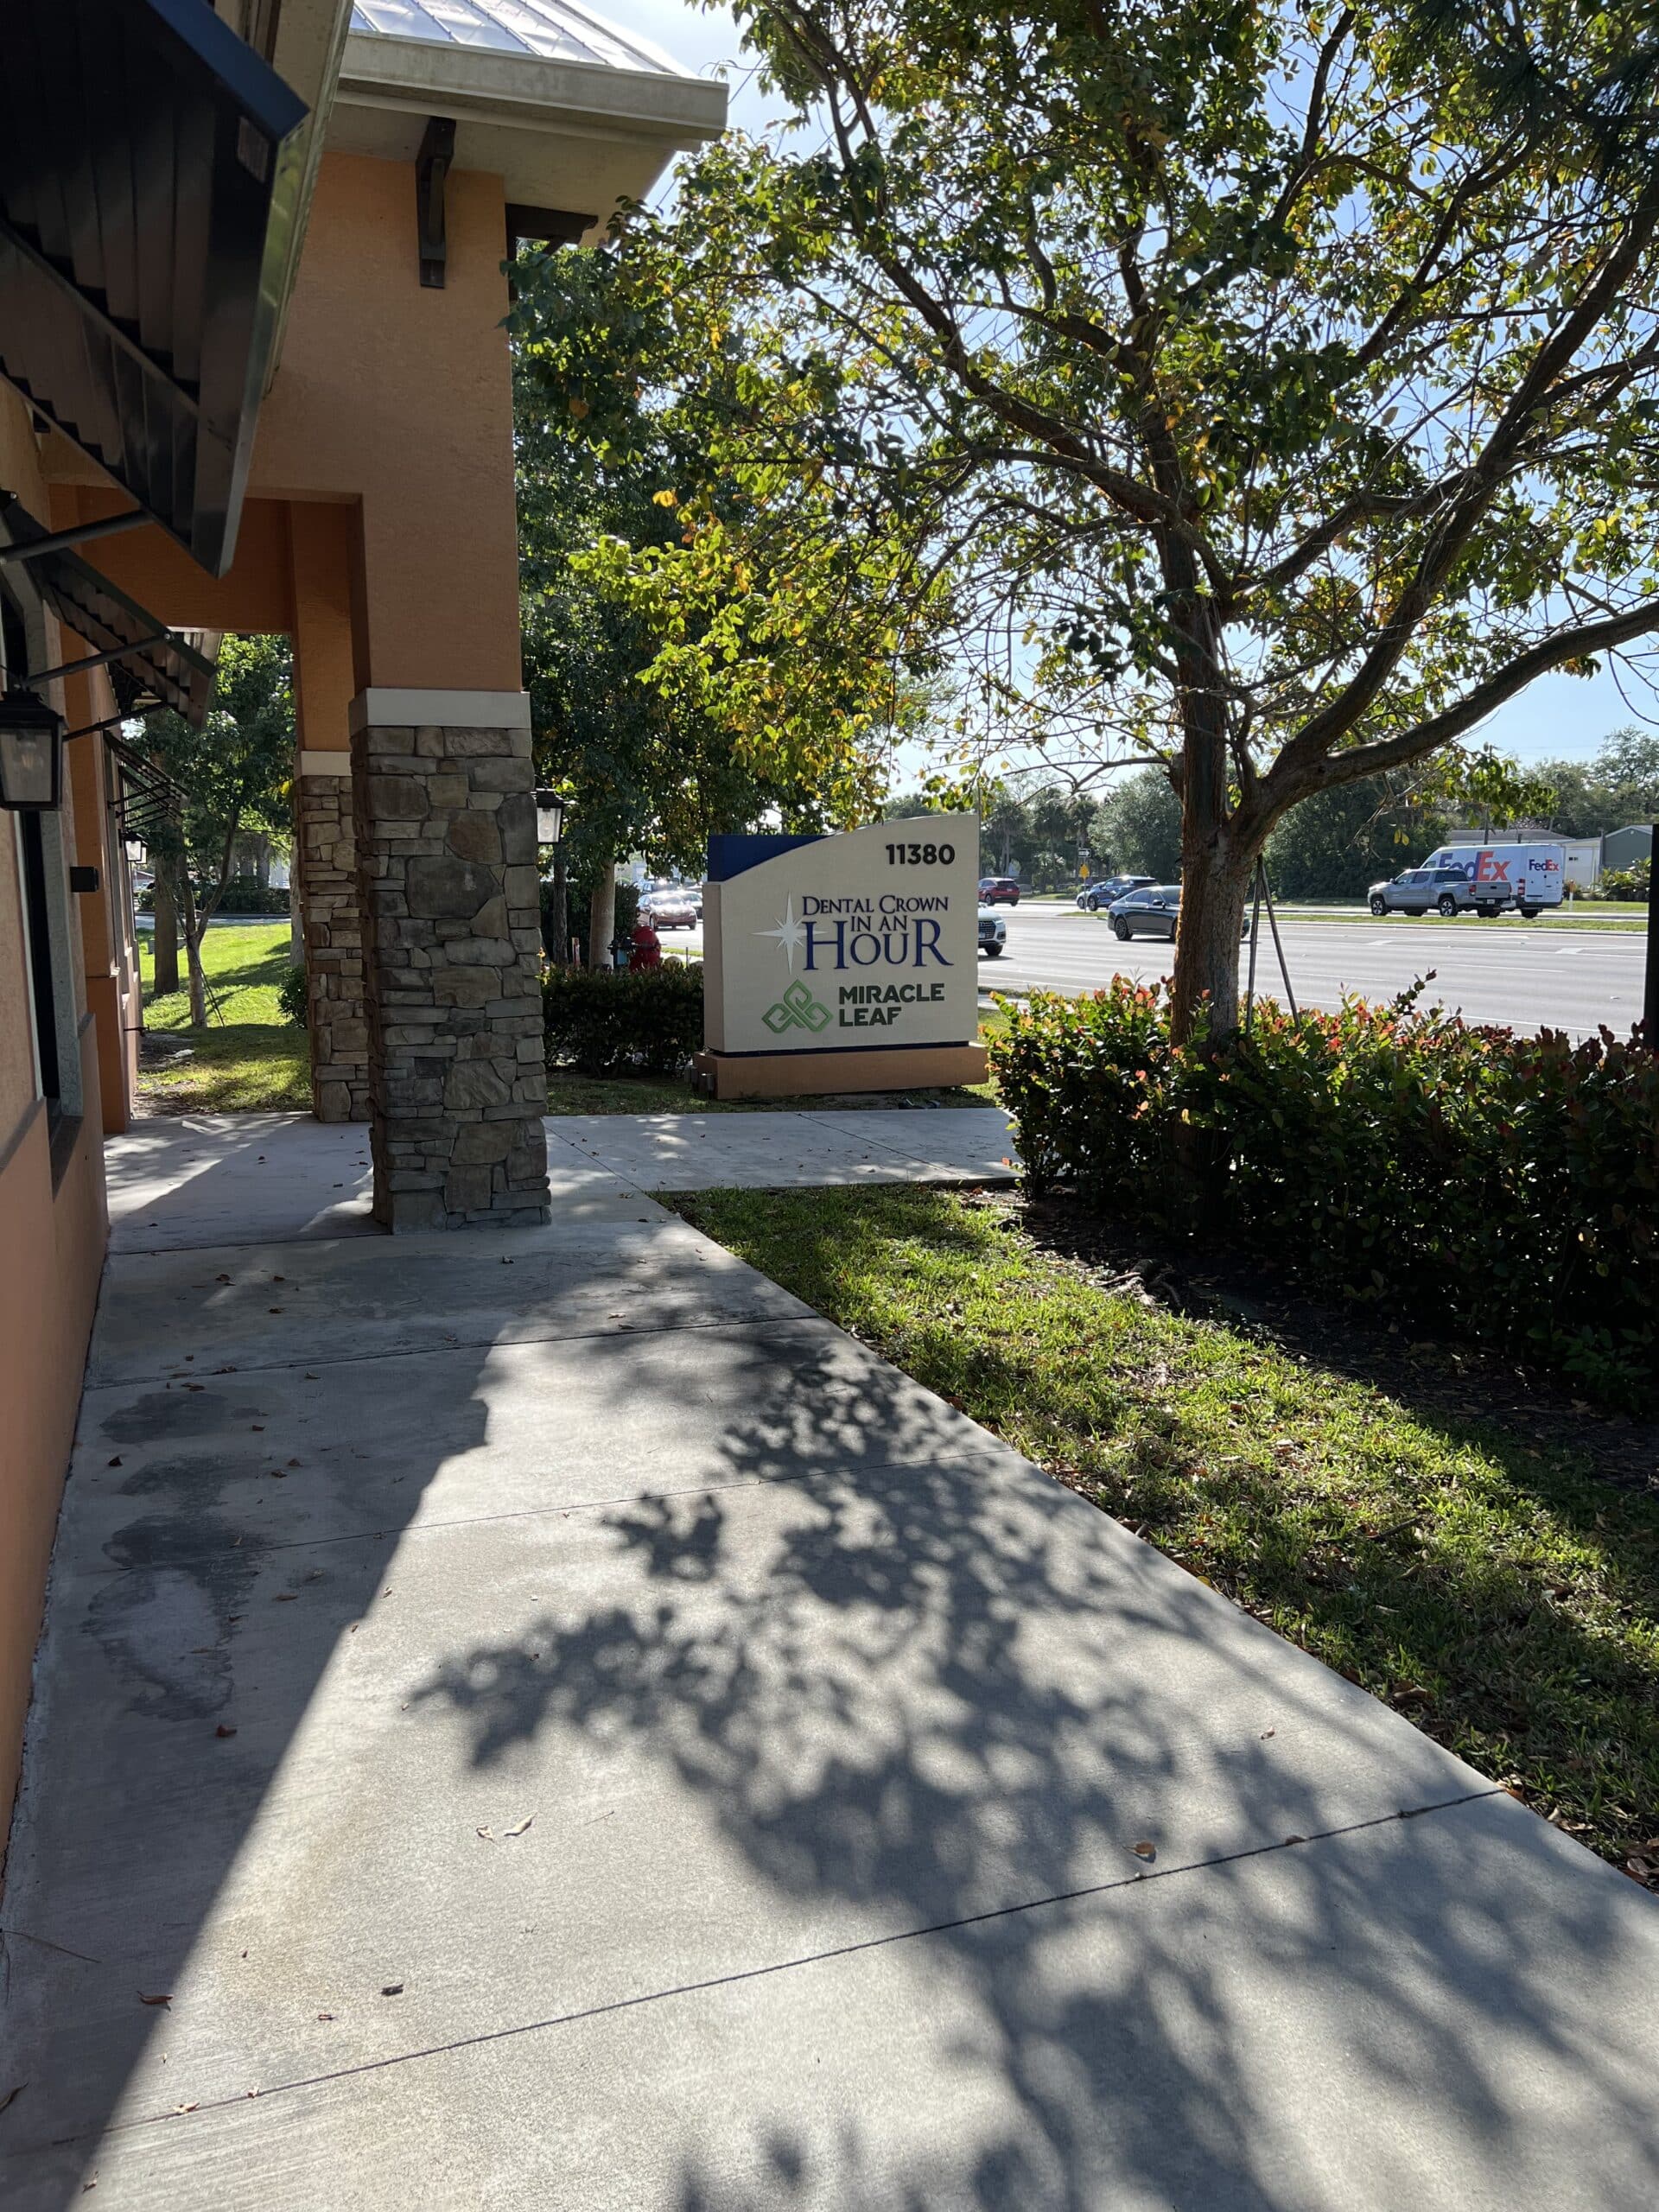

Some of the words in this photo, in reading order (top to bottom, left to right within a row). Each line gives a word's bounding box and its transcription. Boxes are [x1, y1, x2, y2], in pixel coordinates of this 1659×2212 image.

[886, 844, 956, 865] 11380
[1529, 859, 1560, 871] FedEx
[803, 896, 874, 915] DENTAL
[879, 895, 949, 914] CROWN
[850, 916, 871, 931] IN
[878, 915, 907, 931] AN
[801, 918, 954, 970] HOUR
[839, 983, 944, 1005] MIRACLE
[839, 1007, 902, 1027] LEAF
